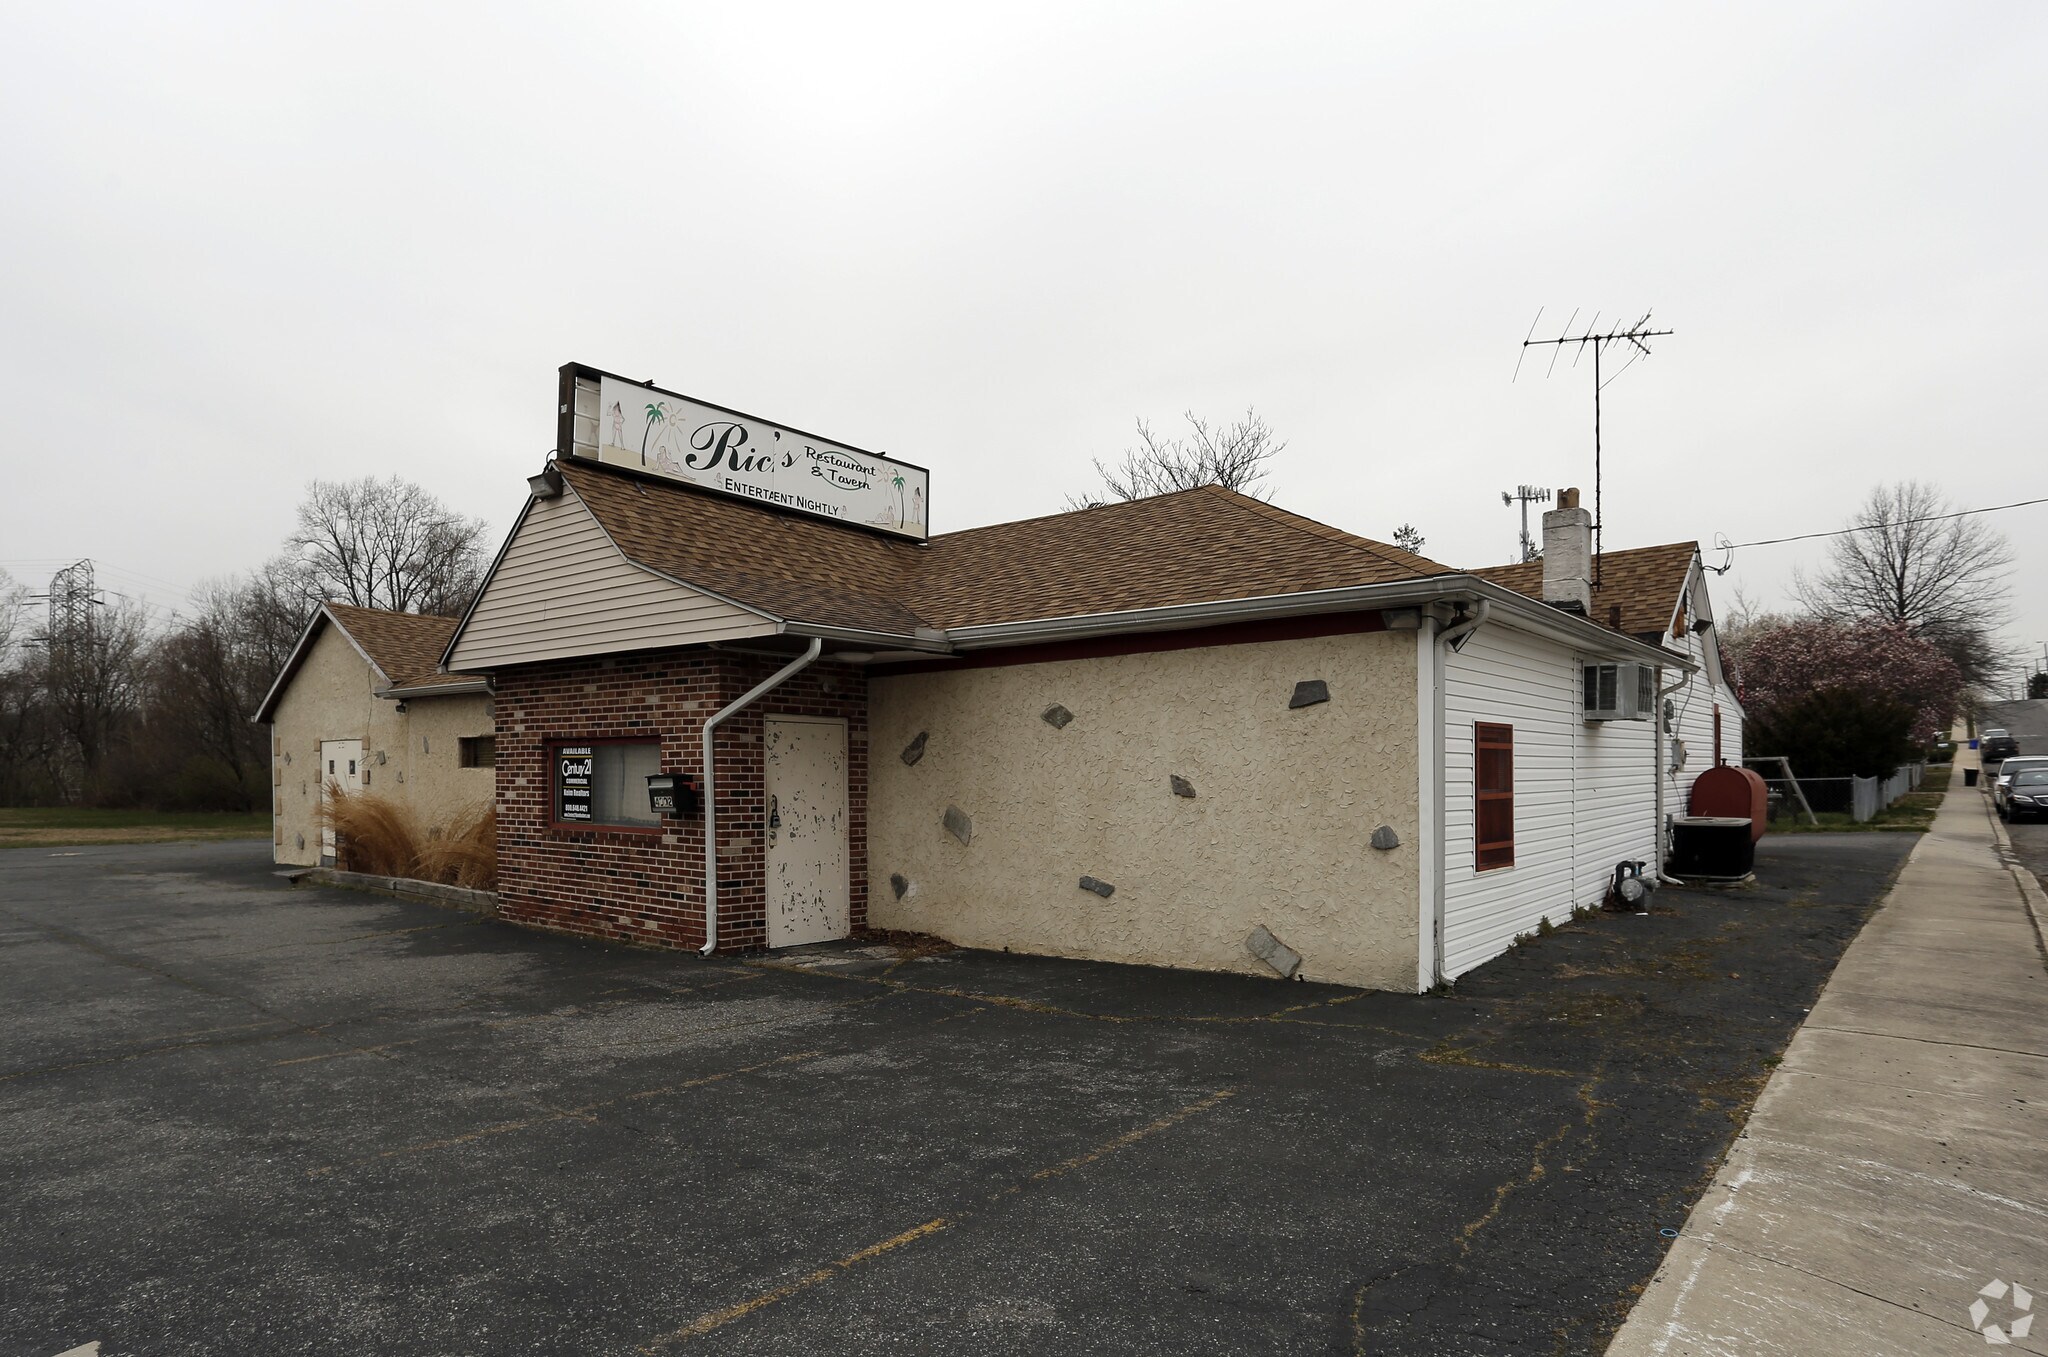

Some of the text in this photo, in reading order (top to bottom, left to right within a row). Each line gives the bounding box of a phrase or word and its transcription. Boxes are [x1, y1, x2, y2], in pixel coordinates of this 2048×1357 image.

[804, 445, 877, 477] Restaurant
[811, 466, 872, 491] & Tavern
[796, 495, 839, 516] NIGHTLY
[562, 759, 592, 777] Century 21
